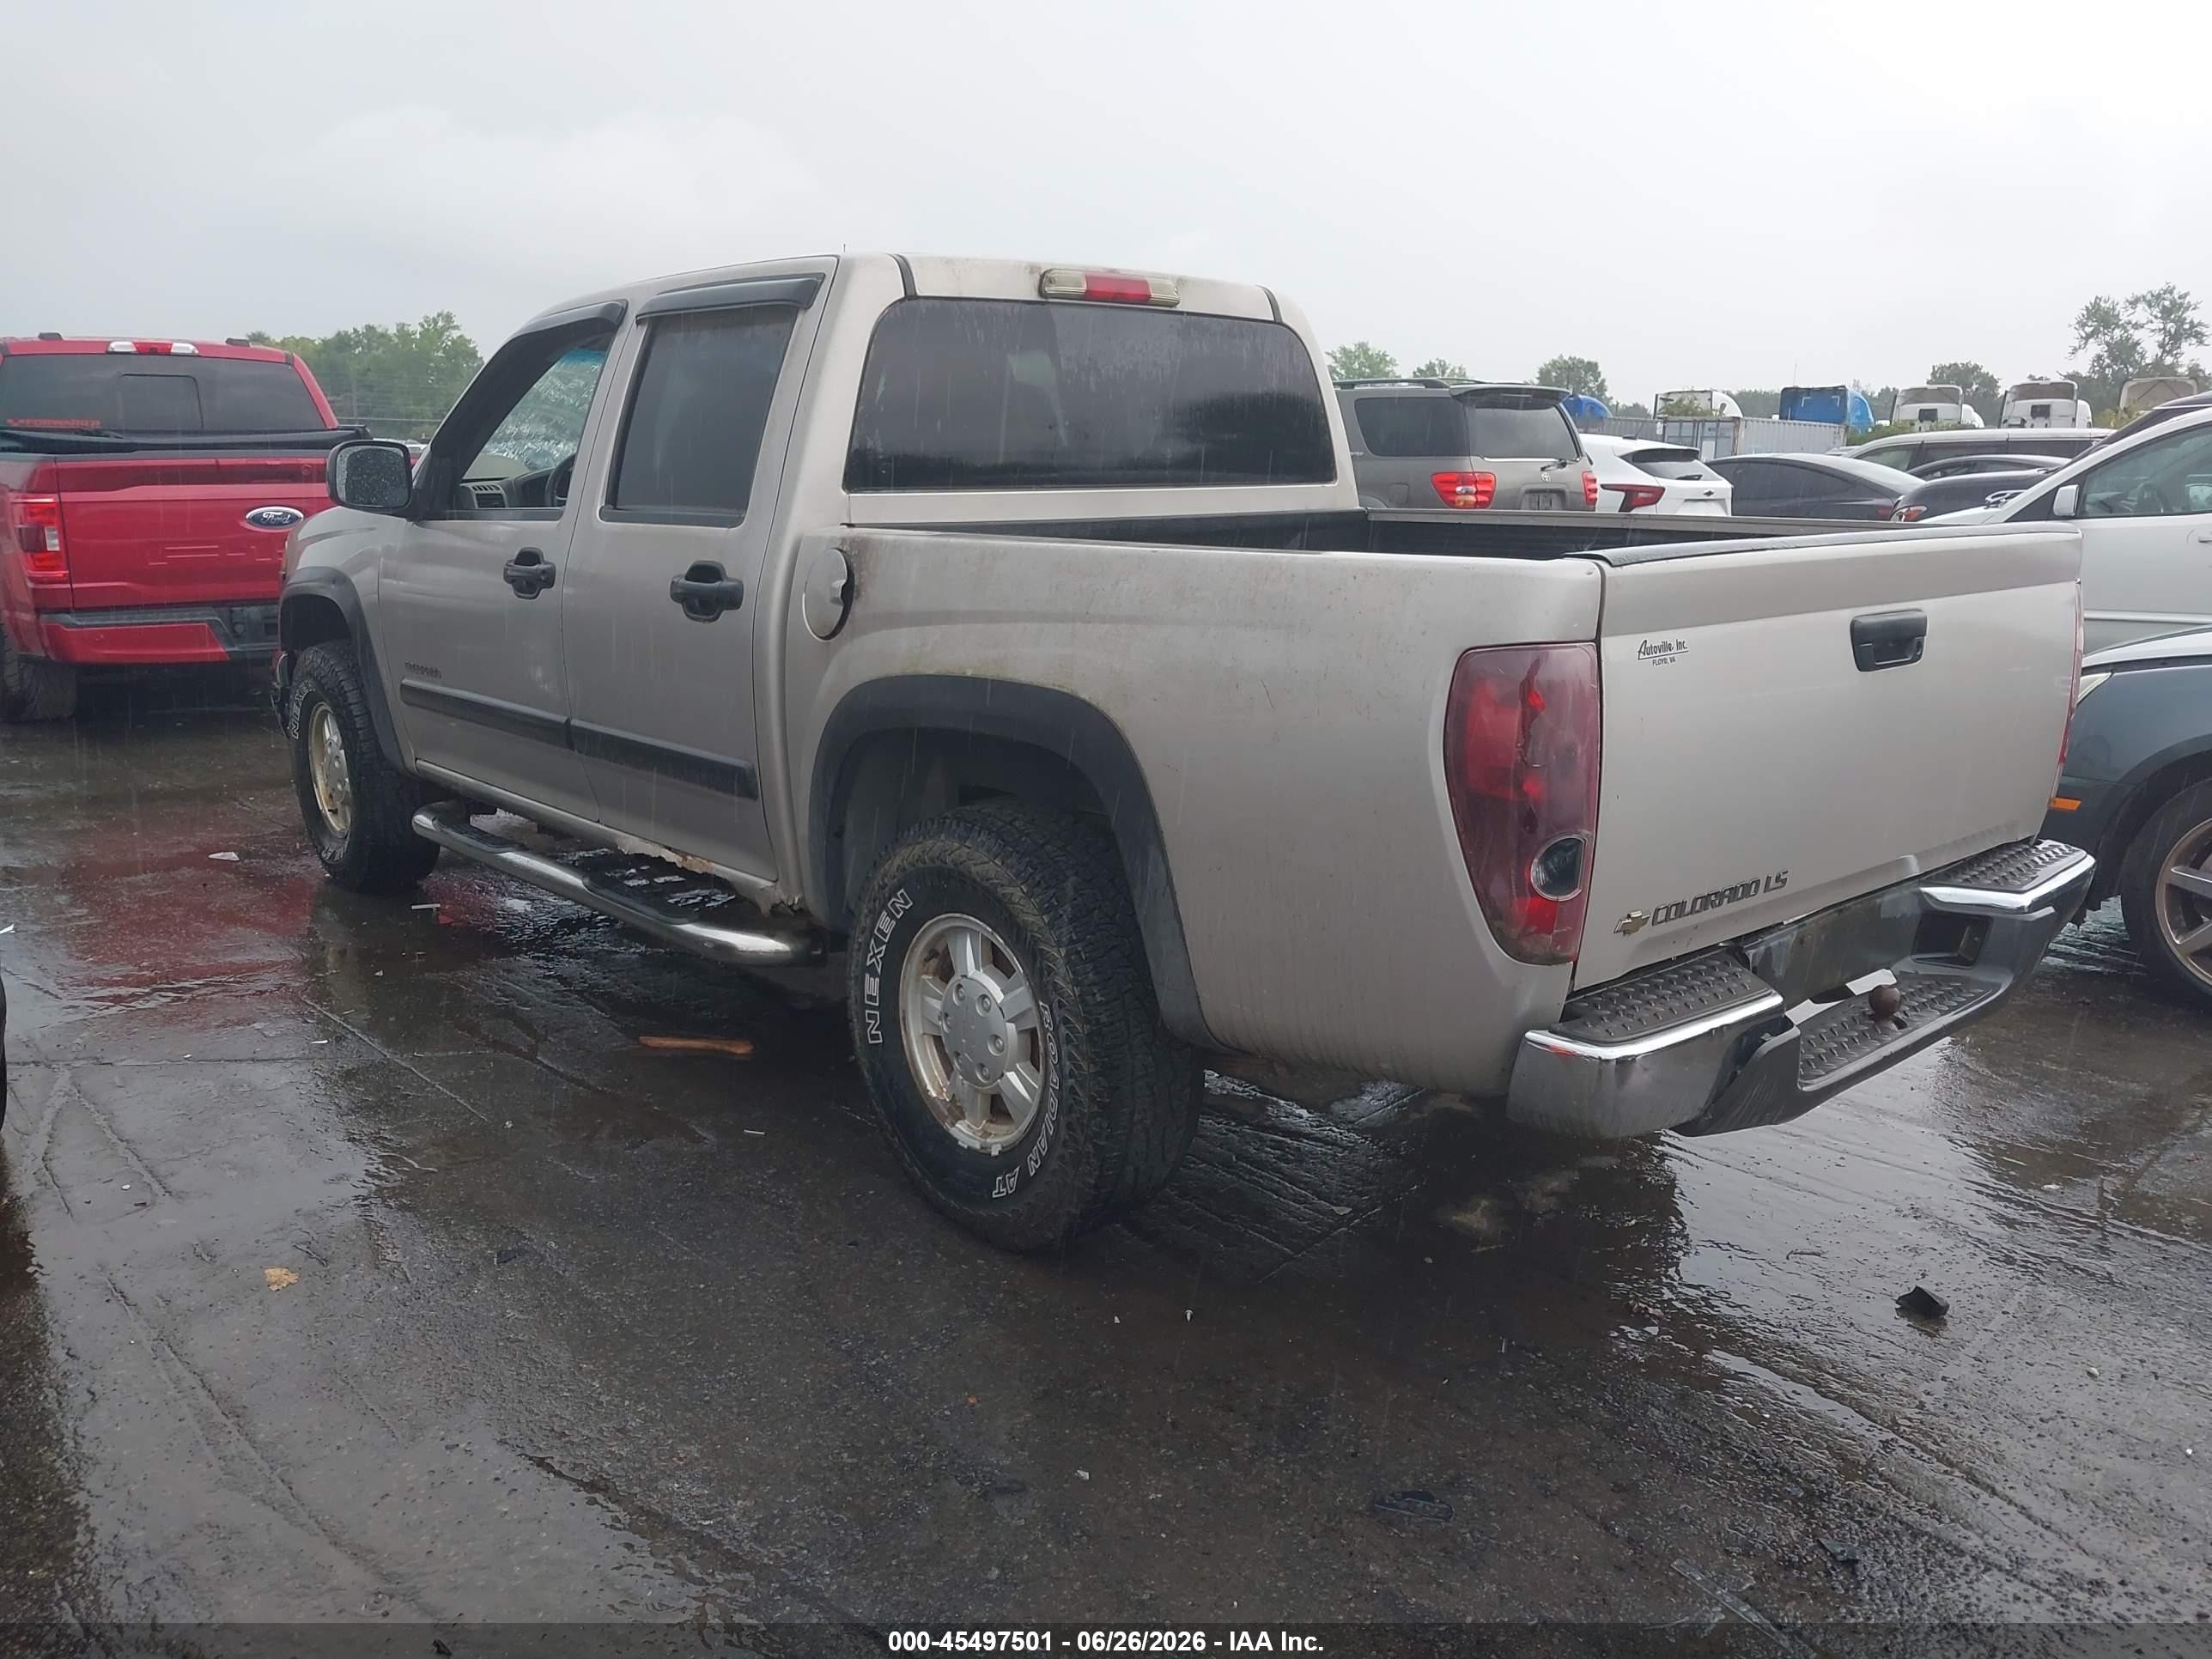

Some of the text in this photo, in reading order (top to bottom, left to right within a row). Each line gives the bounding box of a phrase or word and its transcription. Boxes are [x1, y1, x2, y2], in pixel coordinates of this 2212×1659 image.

[260, 511, 291, 524] Ford
[1638, 638, 1688, 660] Autoville Inc.
[1652, 657, 1669, 666] FLOYD,
[1651, 870, 1789, 927] COLORADO LS
[864, 888, 914, 1044] NEXEN
[992, 1000, 1060, 1198] ROADIAN AT
